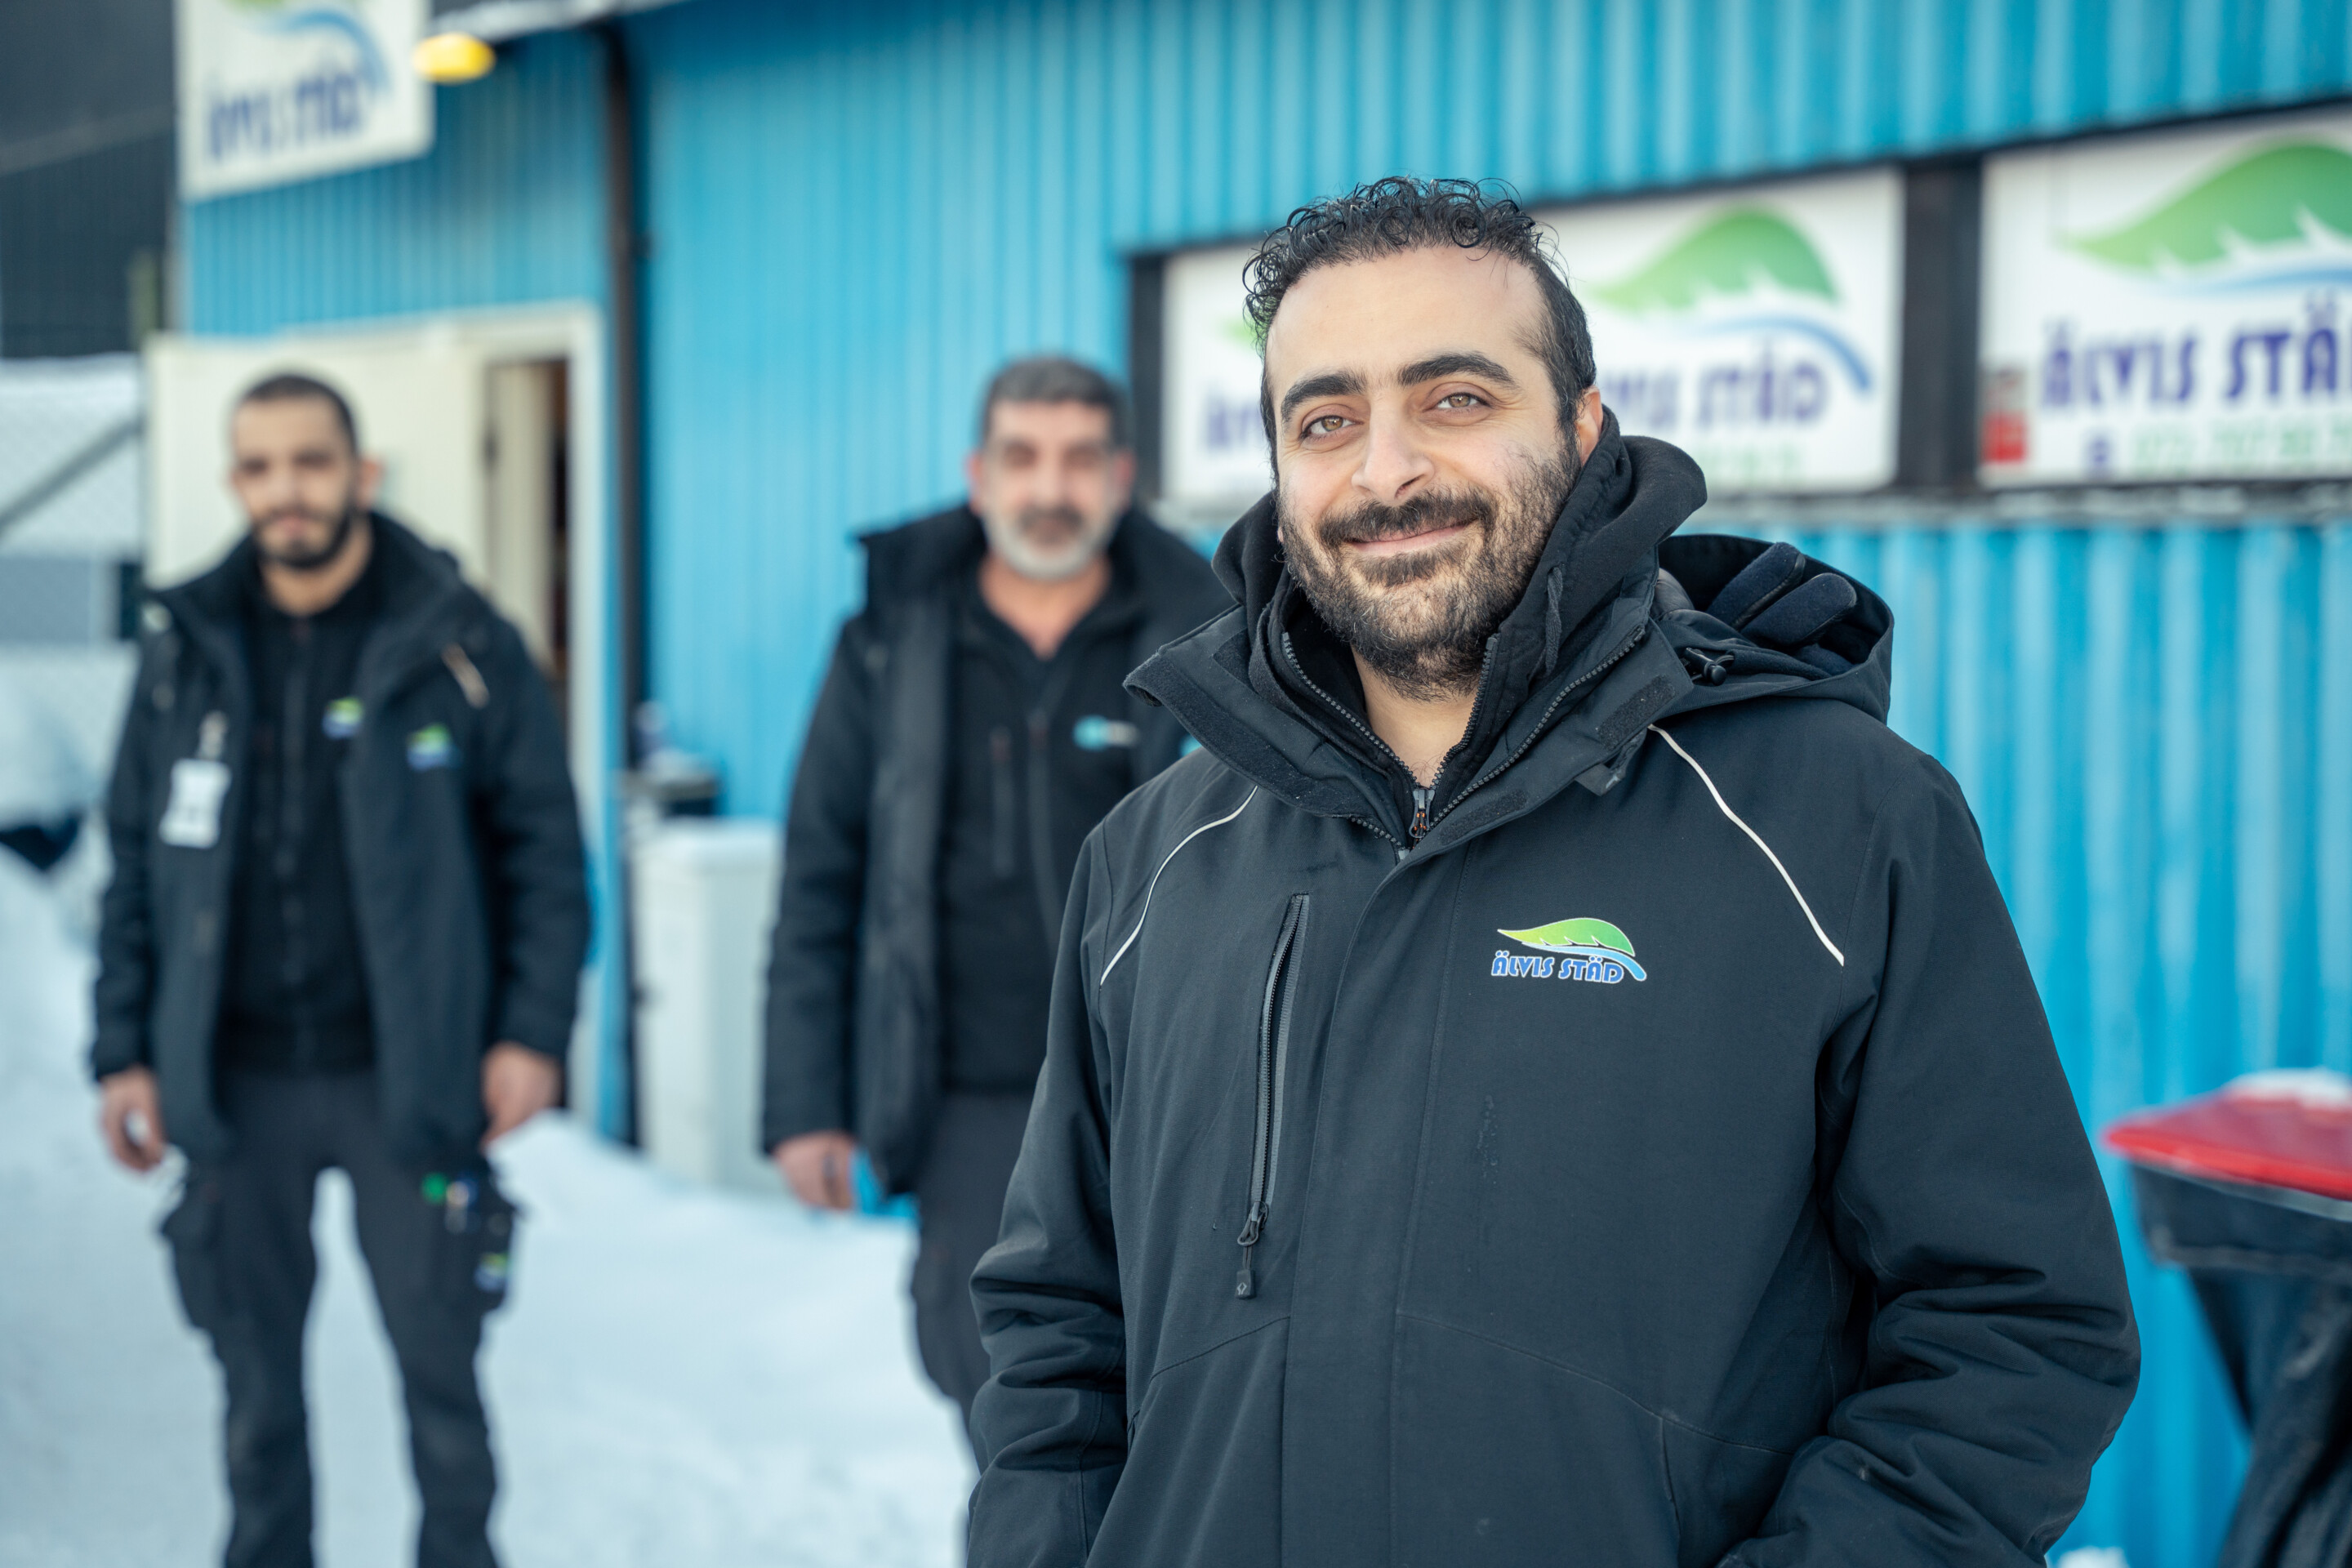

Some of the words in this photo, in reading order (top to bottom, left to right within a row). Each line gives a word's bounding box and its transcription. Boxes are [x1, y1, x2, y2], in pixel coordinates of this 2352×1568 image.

[2226, 290, 2352, 402] STÄ
[1491, 950, 1554, 978] ÄLVIS
[1558, 956, 1624, 983] STÄD
